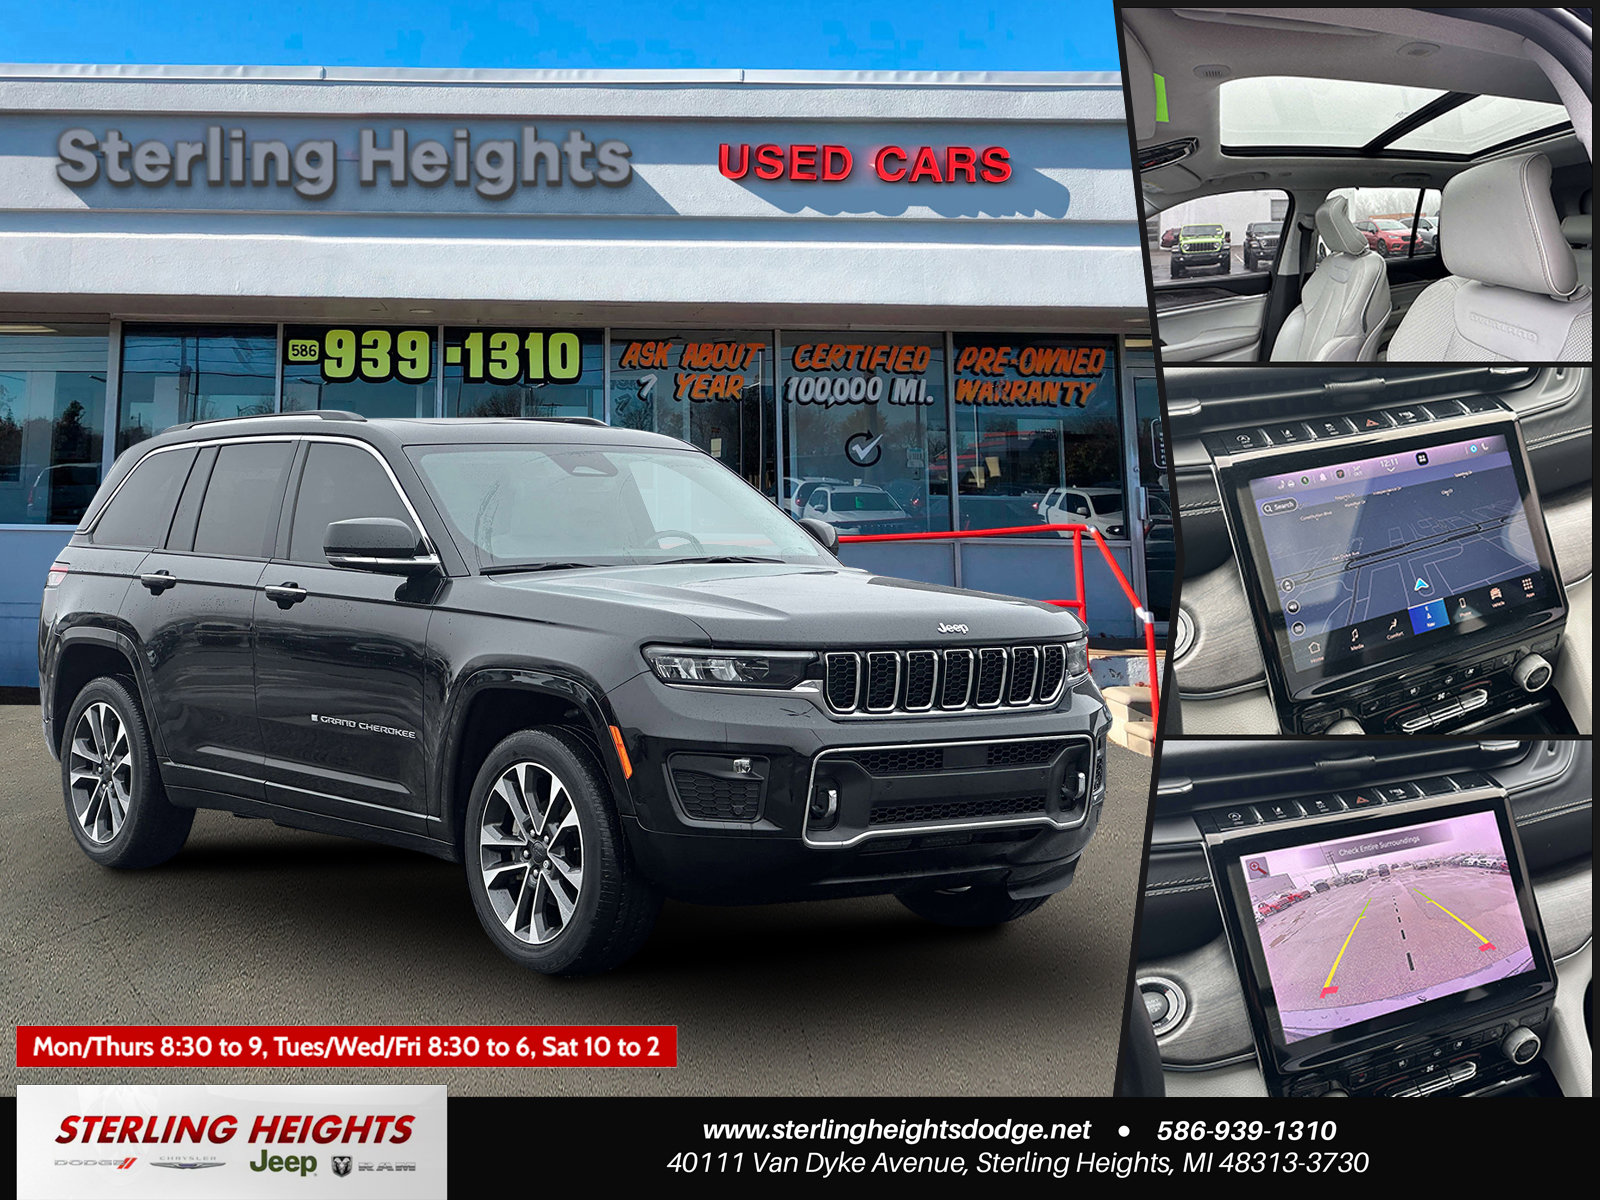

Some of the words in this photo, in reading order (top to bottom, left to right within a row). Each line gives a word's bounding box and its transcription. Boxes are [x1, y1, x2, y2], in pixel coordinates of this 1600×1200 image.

[56, 126, 337, 197] Sterling
[360, 126, 632, 197] Heights
[720, 143, 854, 182] USED
[873, 146, 1012, 184] CARS
[291, 343, 318, 358] 586
[324, 329, 430, 379] 939
[620, 341, 673, 369] ASK
[680, 342, 766, 371] ABOUT
[793, 343, 931, 374] CERTIFIED
[955, 346, 1106, 377] PRE-OWNED
[674, 372, 745, 402] YEAR
[785, 376, 884, 408] 100,000
[890, 377, 935, 405] MI.
[955, 378, 1097, 407] WARRANTY
[1274, 500, 1295, 511] Search
[937, 622, 969, 635] Jeep
[320, 715, 356, 728] GRAND
[358, 722, 416, 739] CHEROKEE
[1338, 846, 1359, 857] Check
[1360, 843, 1379, 853] Entire
[1379, 836, 1421, 849] Surroundings
